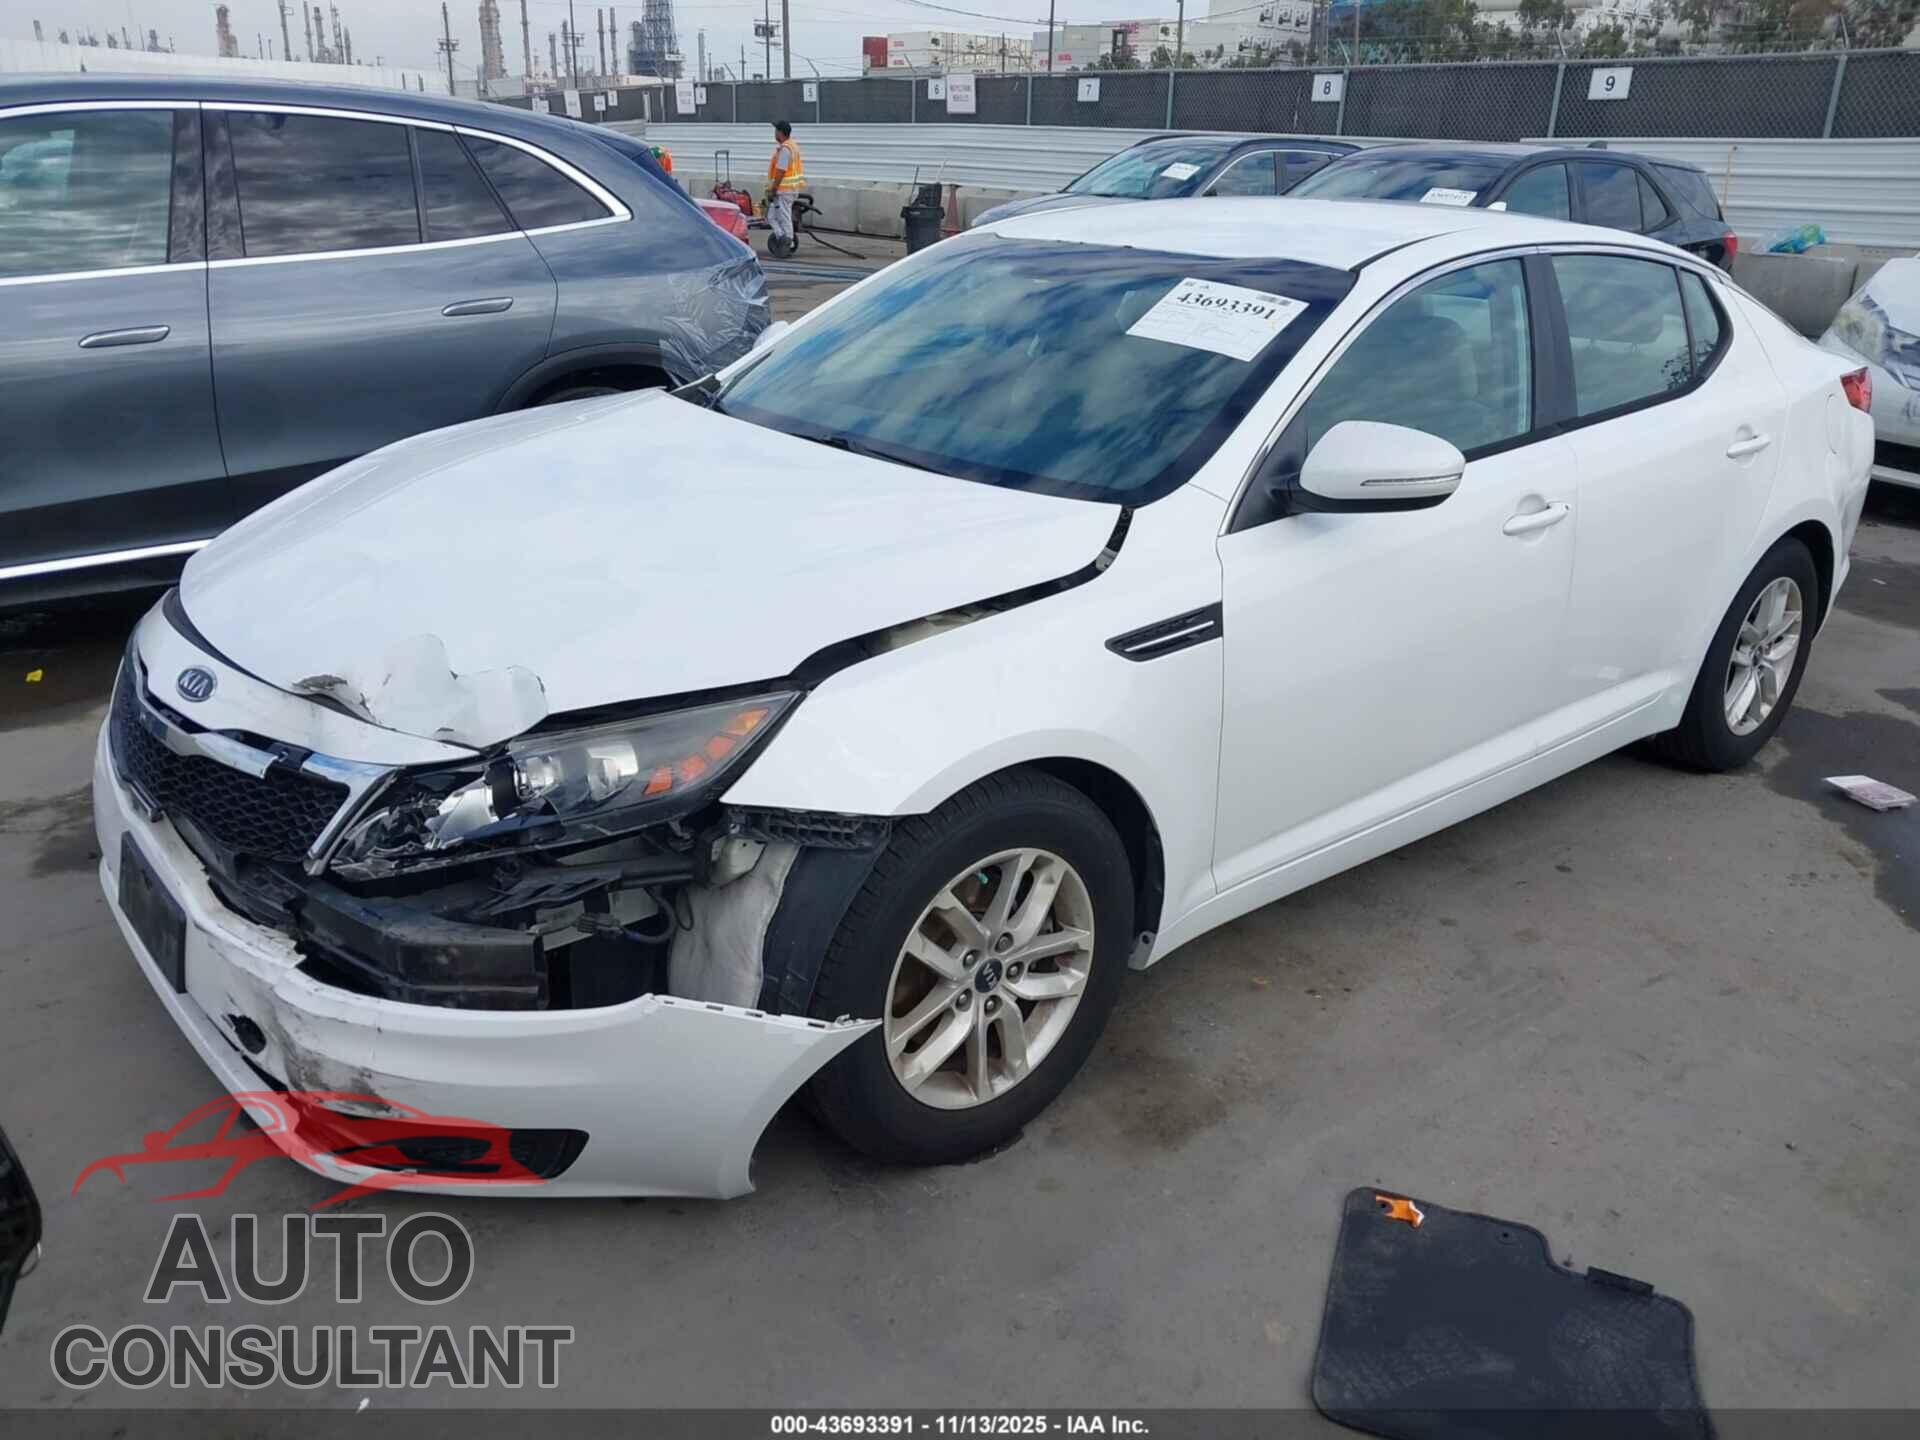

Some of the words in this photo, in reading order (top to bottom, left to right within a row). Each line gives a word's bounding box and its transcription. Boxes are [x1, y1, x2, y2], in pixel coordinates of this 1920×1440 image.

[934, 84, 940, 95] 6
[1085, 84, 1092, 96] 7
[1323, 80, 1332, 96] 8
[1604, 75, 1616, 92] 9
[1177, 292, 1276, 319] 43693391
[179, 670, 209, 697] KIA
